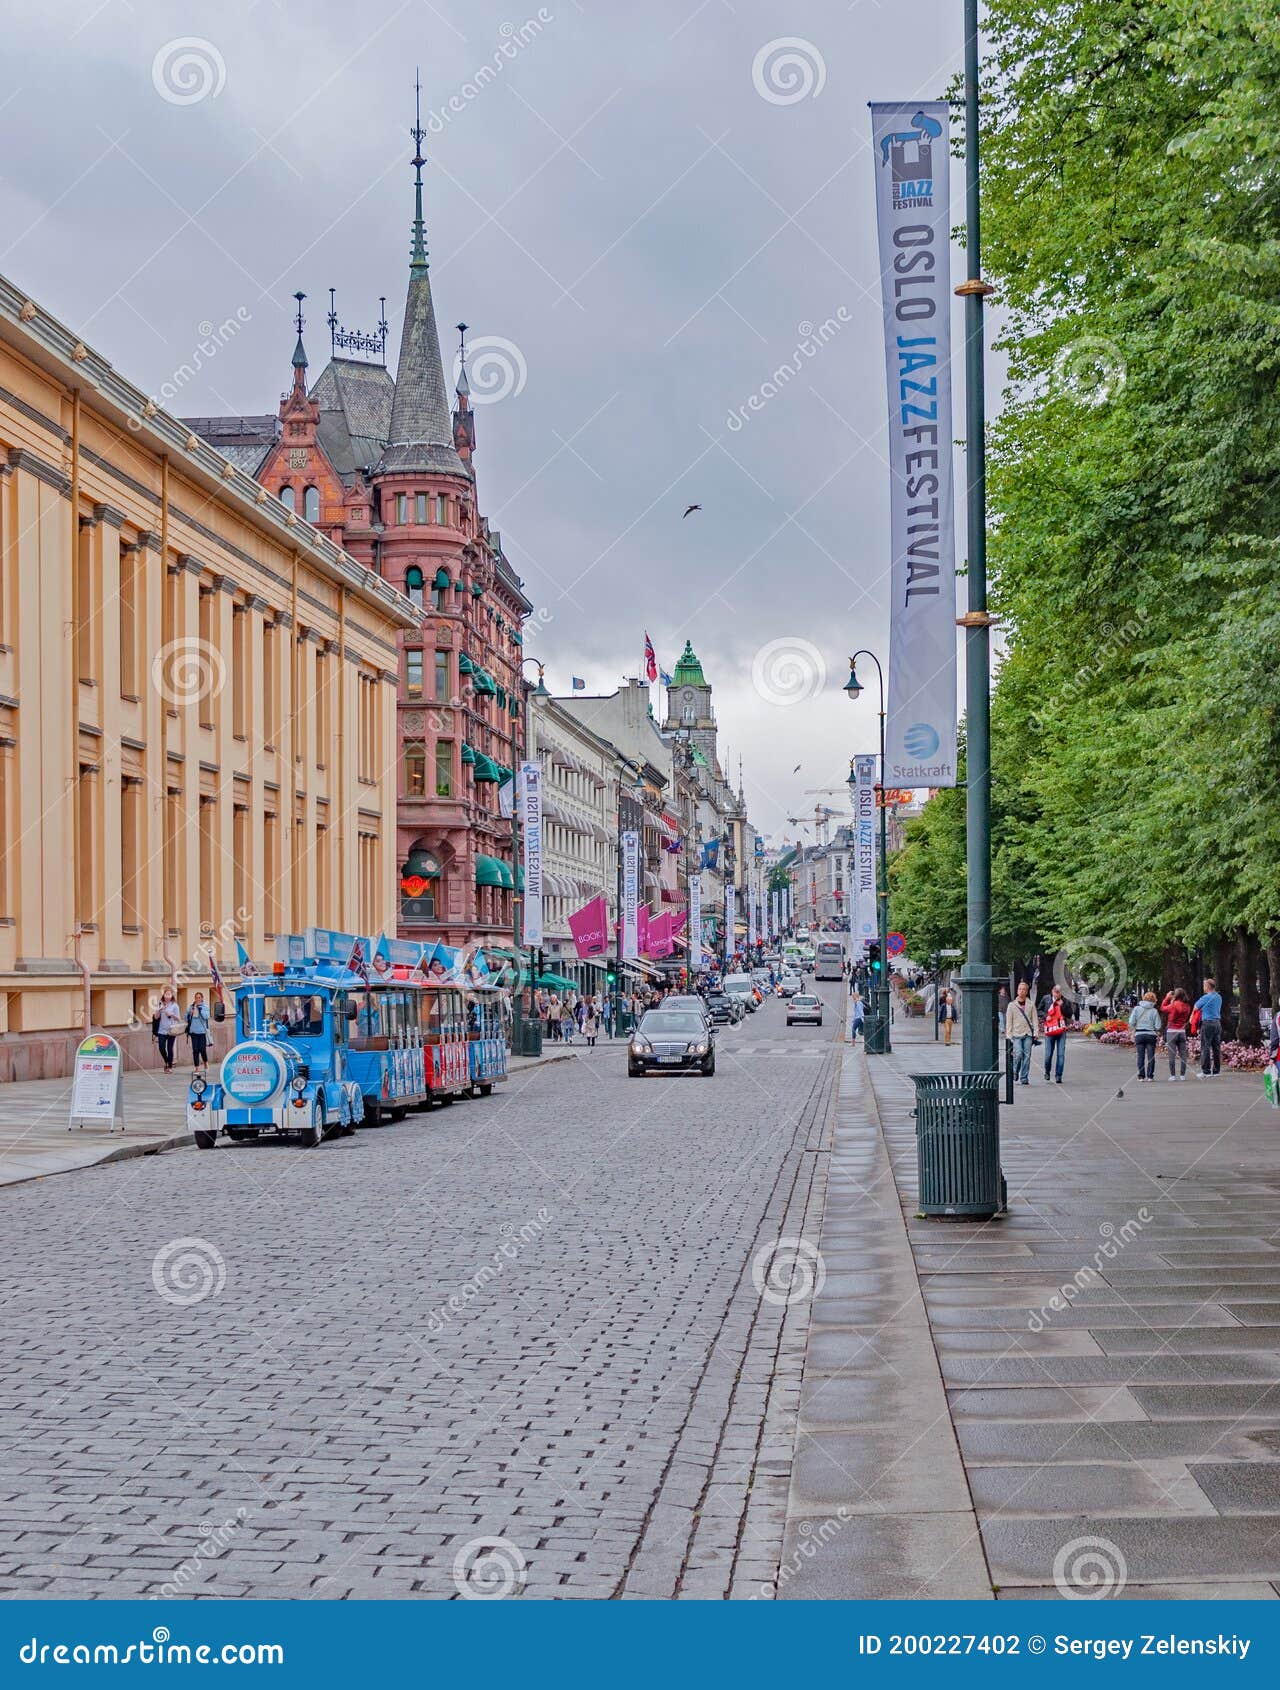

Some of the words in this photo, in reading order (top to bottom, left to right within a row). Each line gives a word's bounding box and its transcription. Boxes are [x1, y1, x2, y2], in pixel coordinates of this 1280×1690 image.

[900, 180, 933, 198] JAZZ
[892, 198, 934, 210] FESTIVAL
[893, 224, 936, 322] OSLO
[896, 336, 940, 608] JAZZFESTIVAL
[892, 763, 951, 778] Statkraft
[860, 789, 871, 817] OSLO
[860, 819, 872, 893] JAZZFESTIVAL
